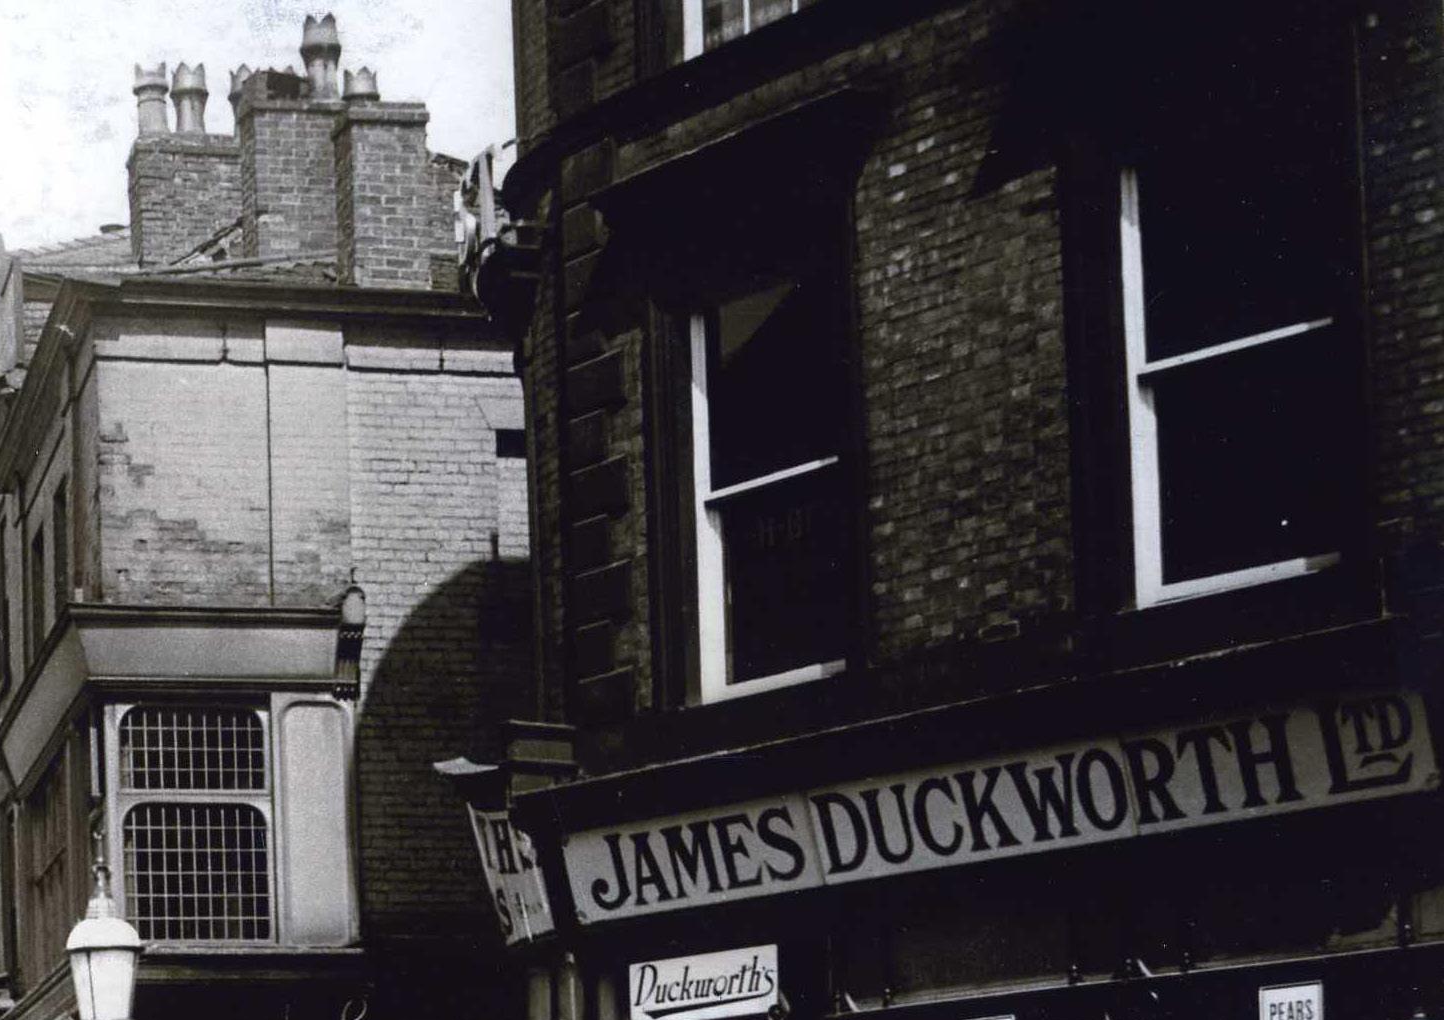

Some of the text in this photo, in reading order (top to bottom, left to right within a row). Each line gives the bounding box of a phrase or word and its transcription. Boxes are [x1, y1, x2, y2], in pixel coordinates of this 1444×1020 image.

[591, 806, 806, 911] JAMES
[809, 711, 1303, 875] DUCKWORTH
[634, 955, 775, 1008] Duckworth's
